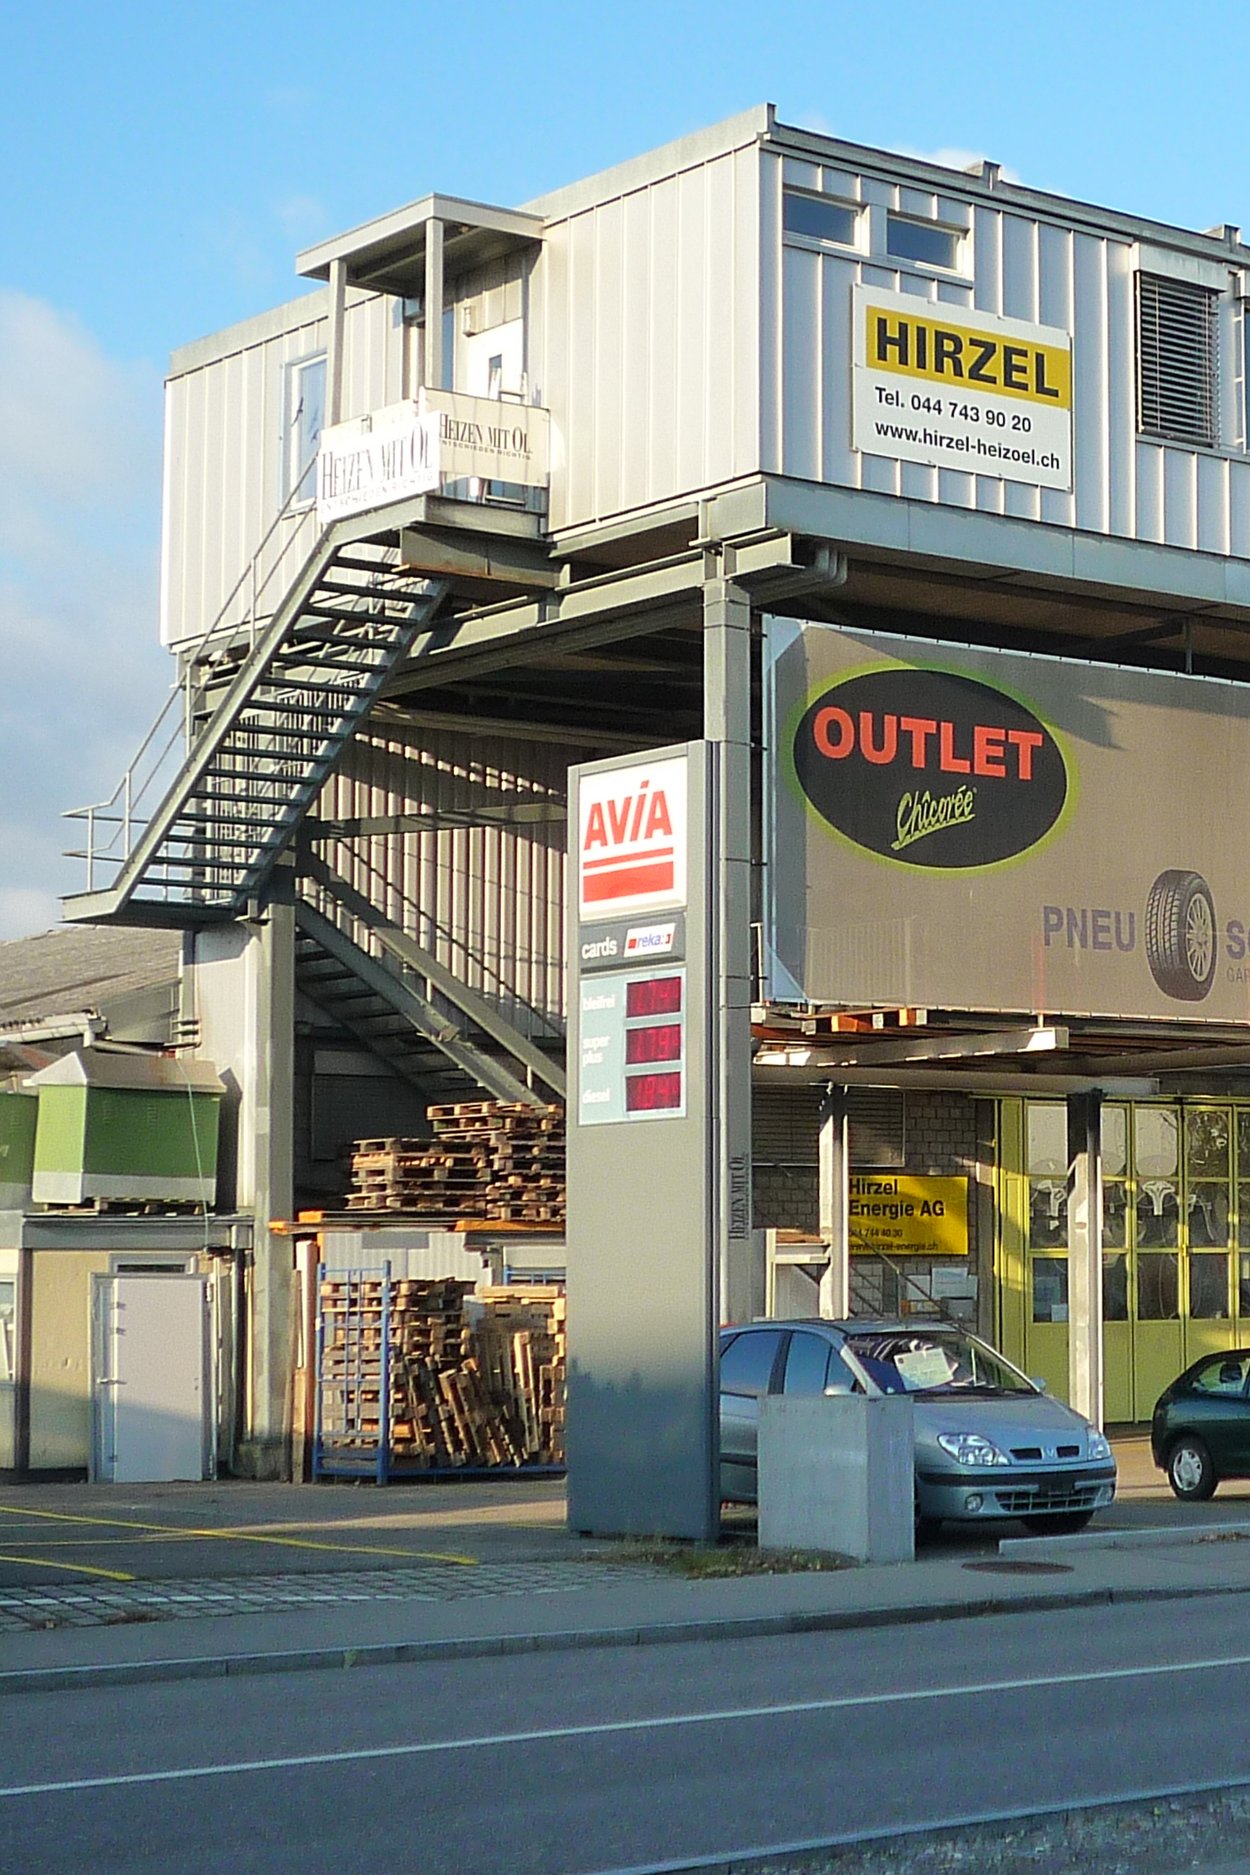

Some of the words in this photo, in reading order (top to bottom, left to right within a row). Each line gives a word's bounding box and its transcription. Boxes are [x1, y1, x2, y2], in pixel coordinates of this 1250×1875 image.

[876, 316, 1060, 399] HIRZEL
[874, 386, 905, 408] Tel.
[910, 394, 943, 416] 044
[949, 401, 980, 423] 743
[985, 409, 1006, 428] 90
[1011, 414, 1032, 433] 20
[874, 421, 1061, 471] www.hirzel-heizoel.ch
[813, 705, 1044, 781] OUTLET
[583, 779, 674, 851] AVIA
[581, 936, 618, 960] cards
[1042, 904, 1137, 953] PNEU
[849, 1178, 898, 1196] Hirzel
[849, 1199, 915, 1220] Energie
[919, 1199, 945, 1217] AG
